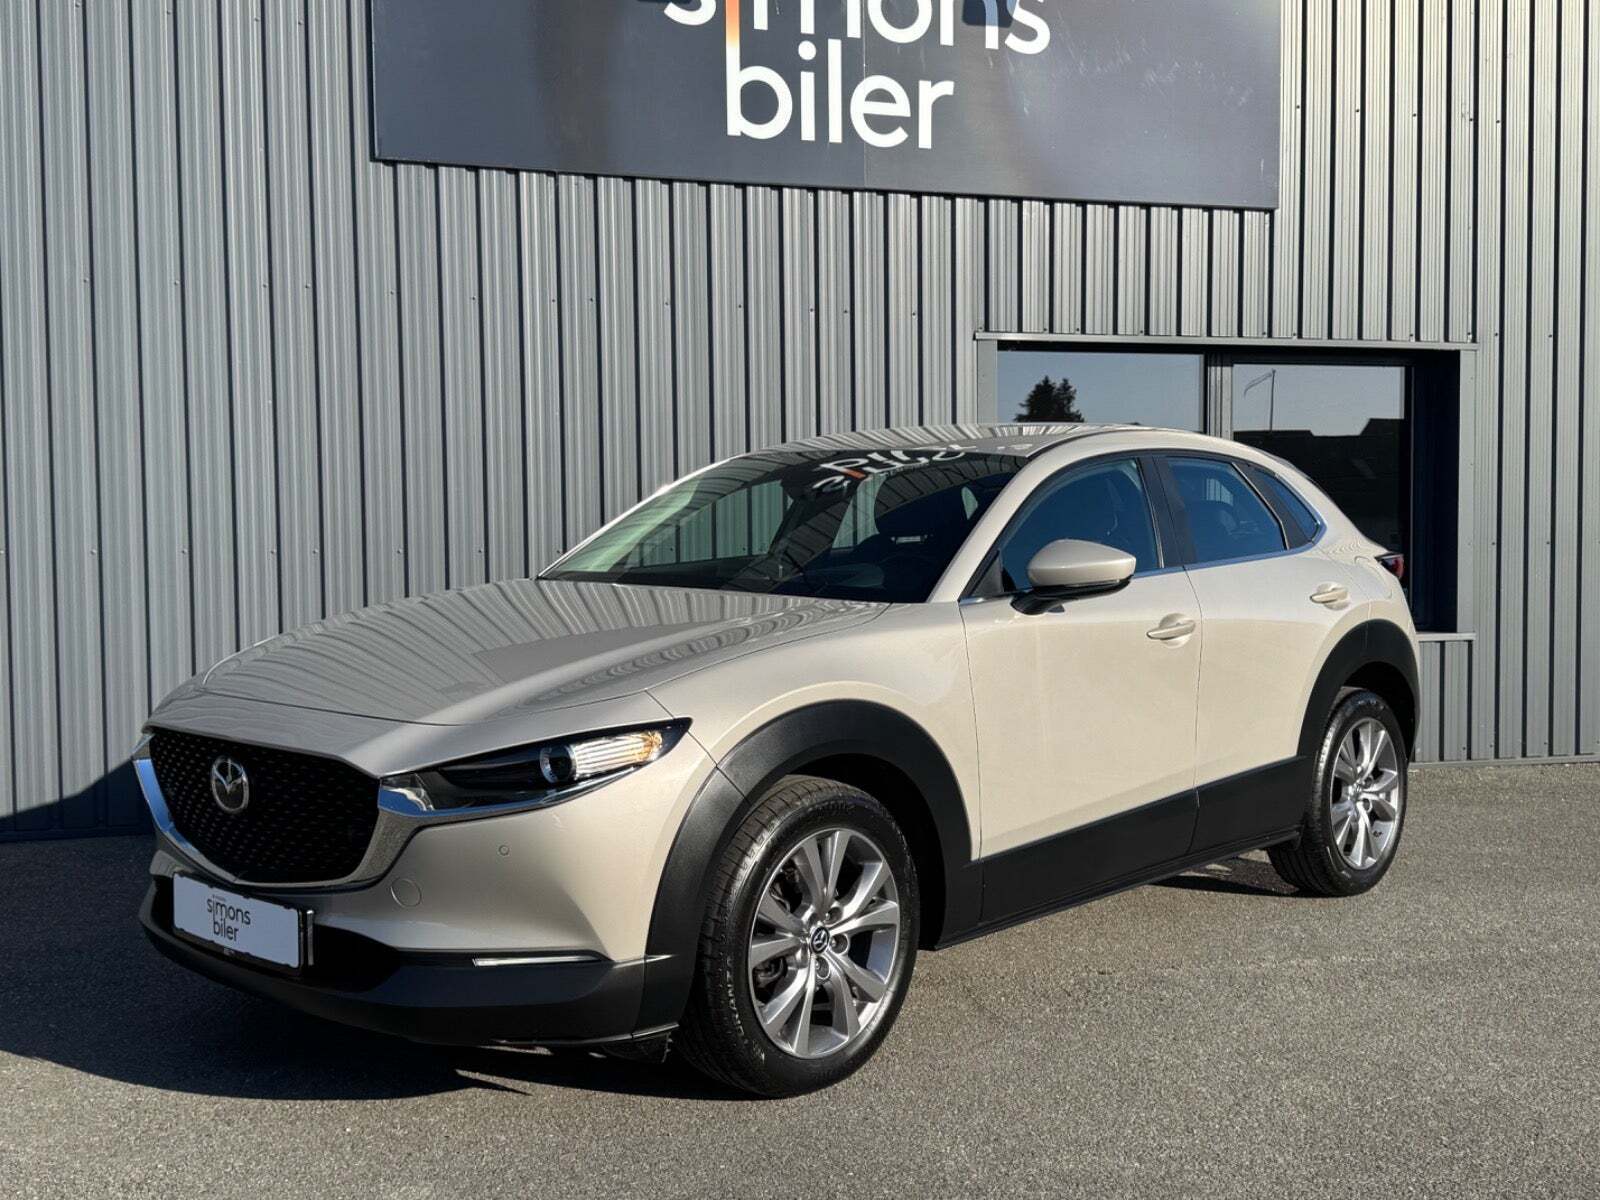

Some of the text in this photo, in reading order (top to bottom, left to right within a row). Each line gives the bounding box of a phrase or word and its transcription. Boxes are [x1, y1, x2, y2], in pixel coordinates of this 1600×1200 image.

[726, 38, 954, 149] biler
[207, 896, 251, 925] simons
[213, 917, 239, 942] biler
